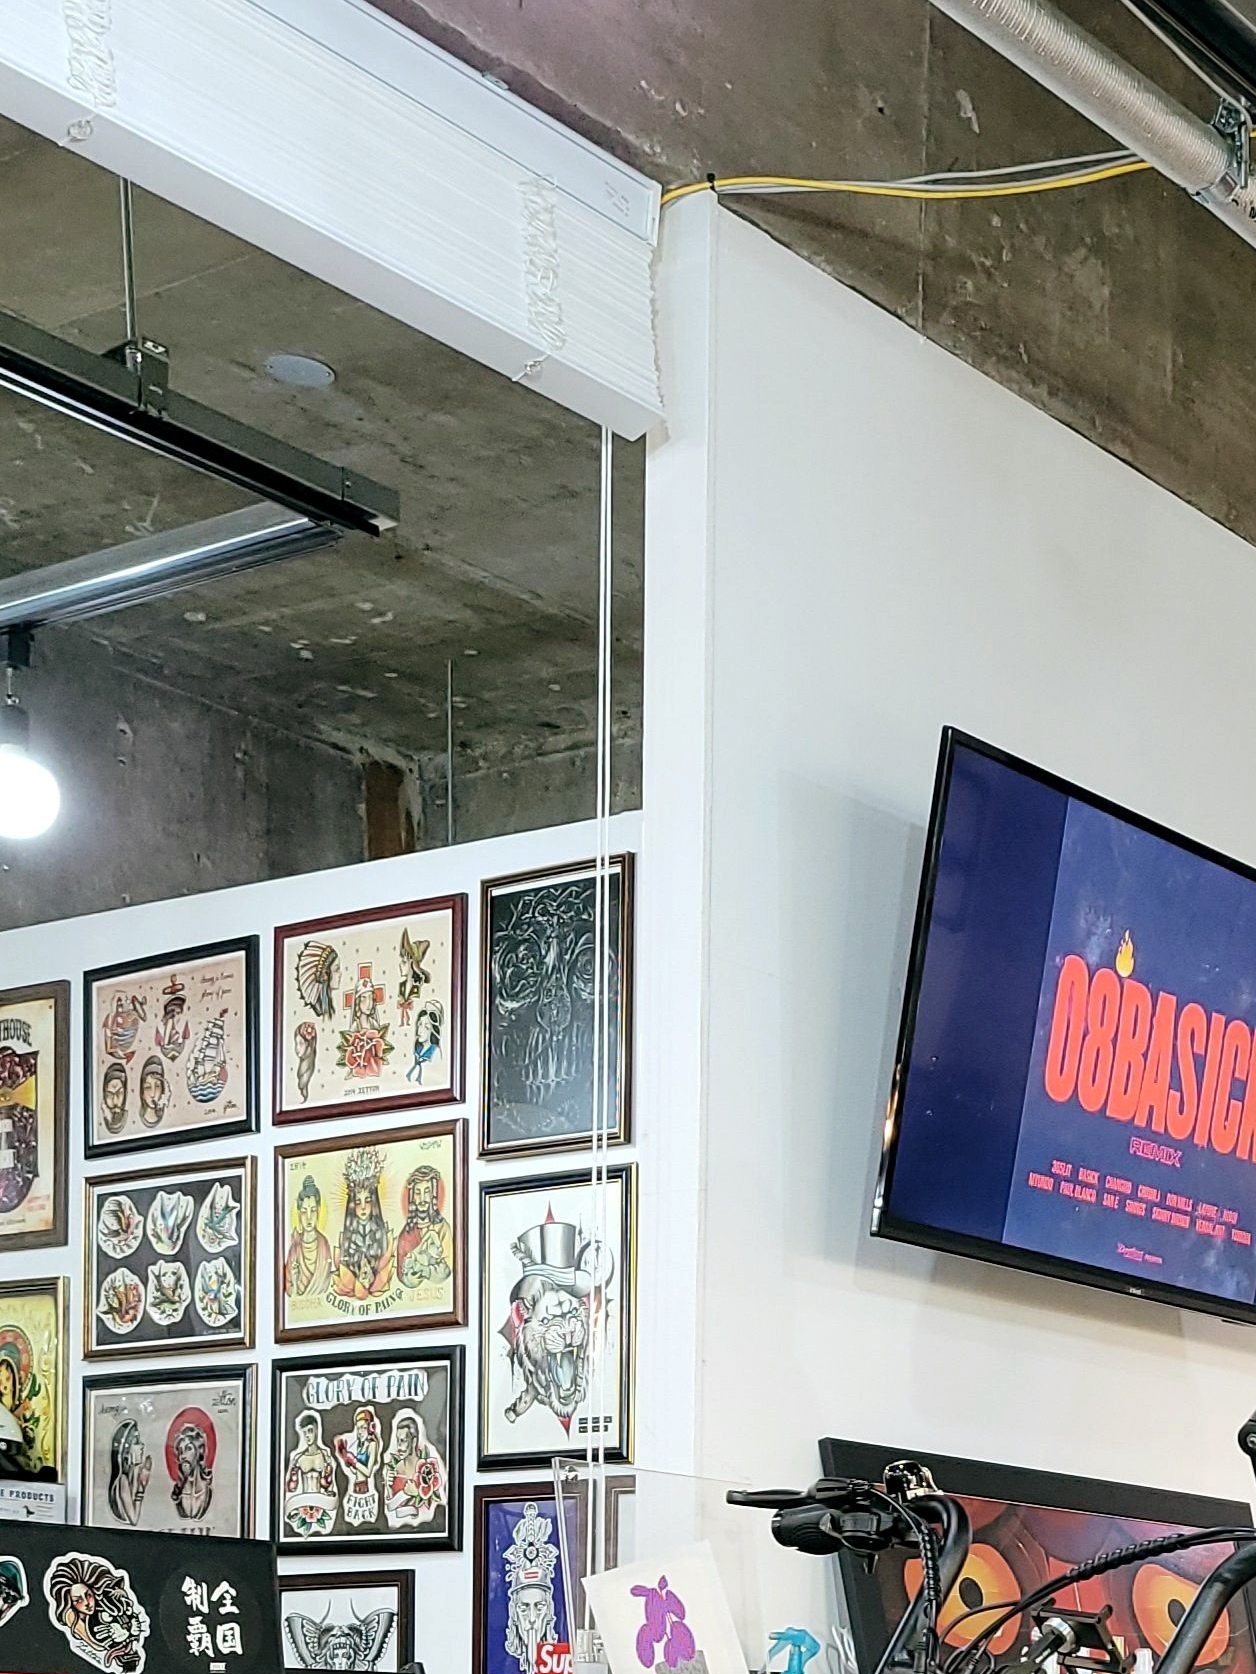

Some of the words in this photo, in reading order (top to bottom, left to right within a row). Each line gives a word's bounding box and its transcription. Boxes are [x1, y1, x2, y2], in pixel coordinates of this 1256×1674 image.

[1129, 1136, 1183, 1168] REMIX
[409, 1286, 446, 1302] JESUS
[358, 1302, 372, 1316] OF
[305, 1376, 356, 1405] GLORY
[360, 1375, 380, 1400] OF
[385, 1372, 427, 1399] PAIN
[9, 1489, 55, 1503] PRODUCTS
[346, 1506, 377, 1521] BACK
